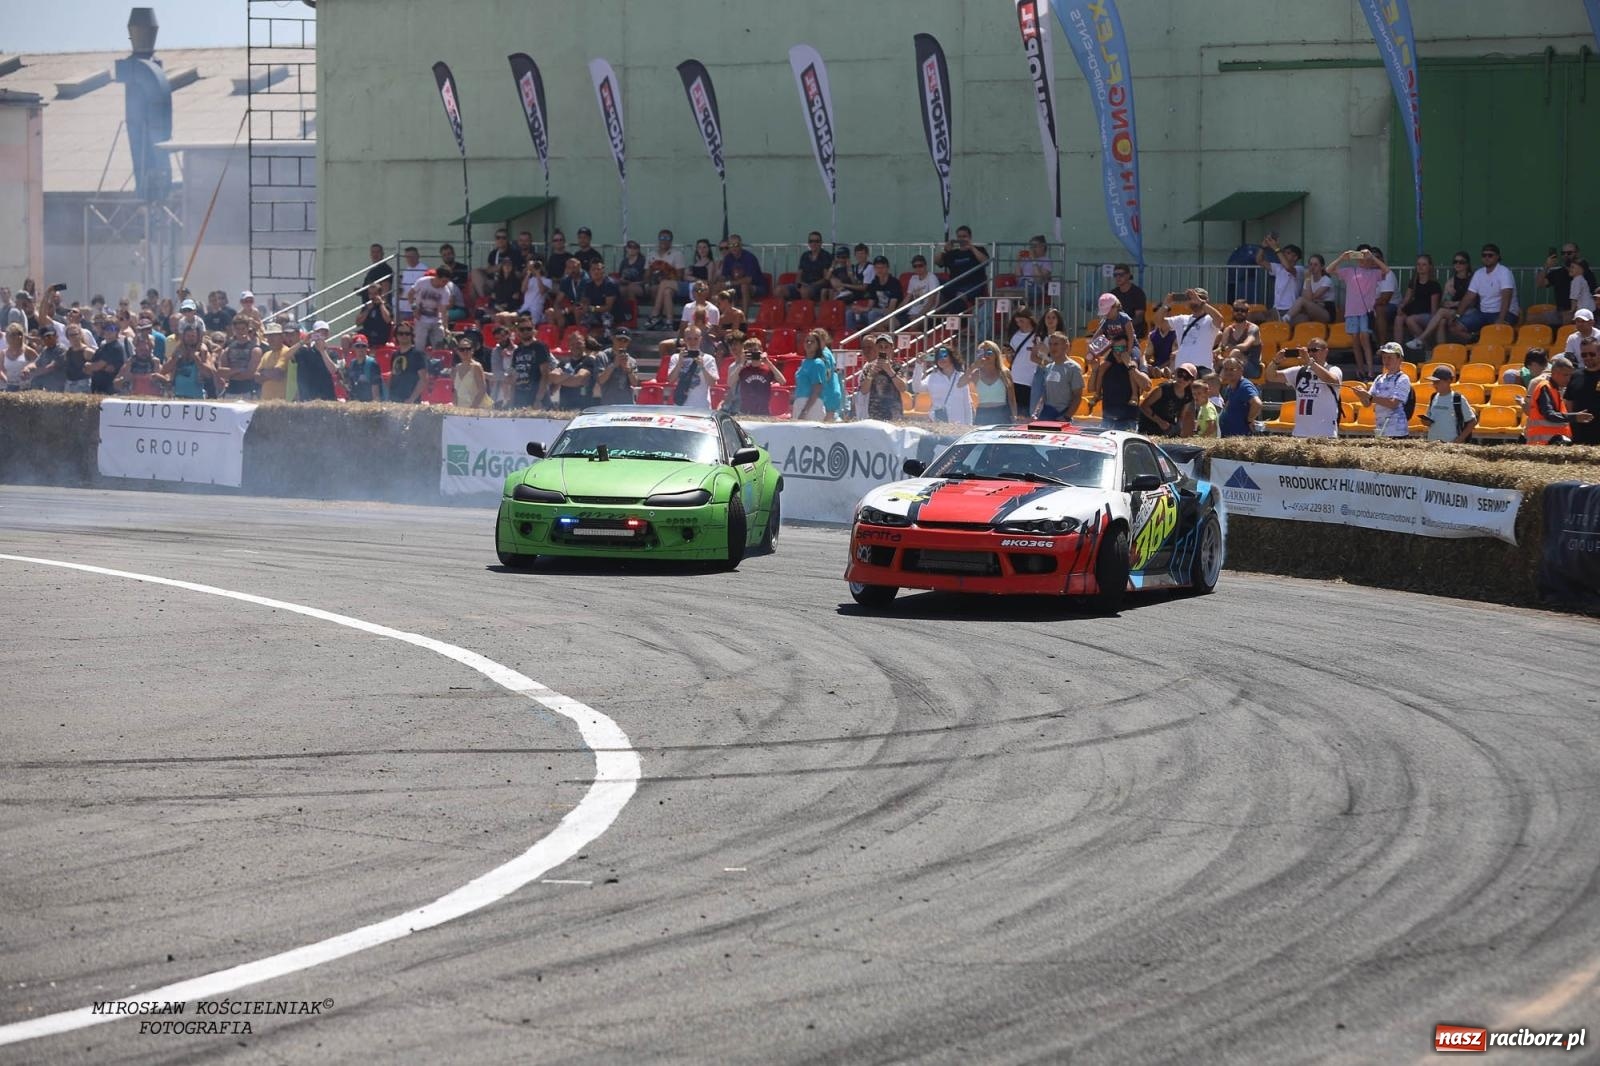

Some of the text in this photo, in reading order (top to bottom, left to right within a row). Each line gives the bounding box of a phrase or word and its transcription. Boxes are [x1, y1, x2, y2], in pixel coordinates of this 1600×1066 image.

[123, 403, 217, 422] AUTO FUS
[136, 438, 200, 456] GROUP
[1425, 489, 1468, 509] WYNAJEM
[1310, 503, 1322, 513] 229
[1323, 503, 1335, 514] 831
[1001, 538, 1054, 548] #KO366
